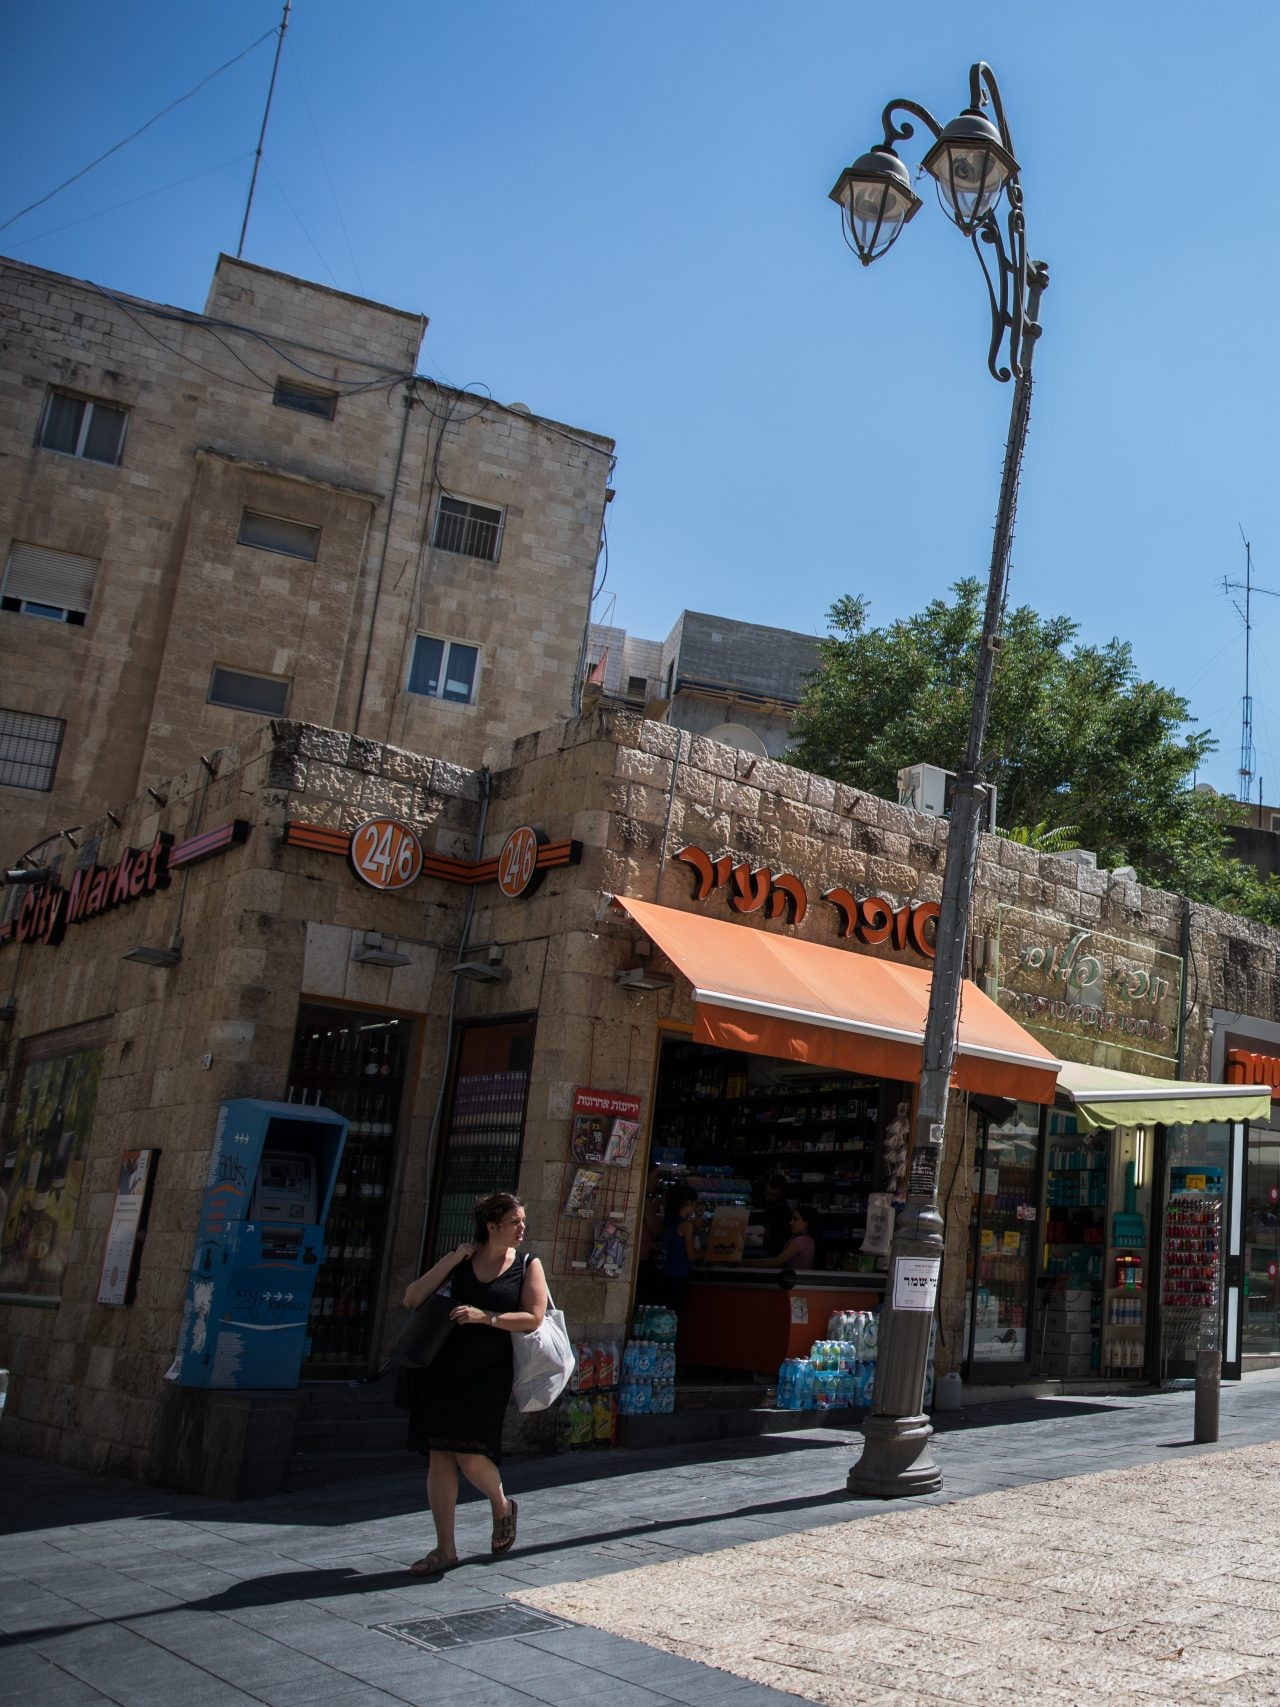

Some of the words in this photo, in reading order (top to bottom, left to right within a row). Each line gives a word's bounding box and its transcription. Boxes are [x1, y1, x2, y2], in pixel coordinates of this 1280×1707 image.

[361, 823, 415, 887] 24/6
[503, 832, 534, 890] 24/6
[674, 845, 808, 925] העיר
[16, 882, 65, 945] City
[66, 831, 166, 924] Market
[820, 887, 940, 958] סופר
[577, 1095, 609, 1109] אחרונות
[610, 1100, 639, 1112] ידיעות
